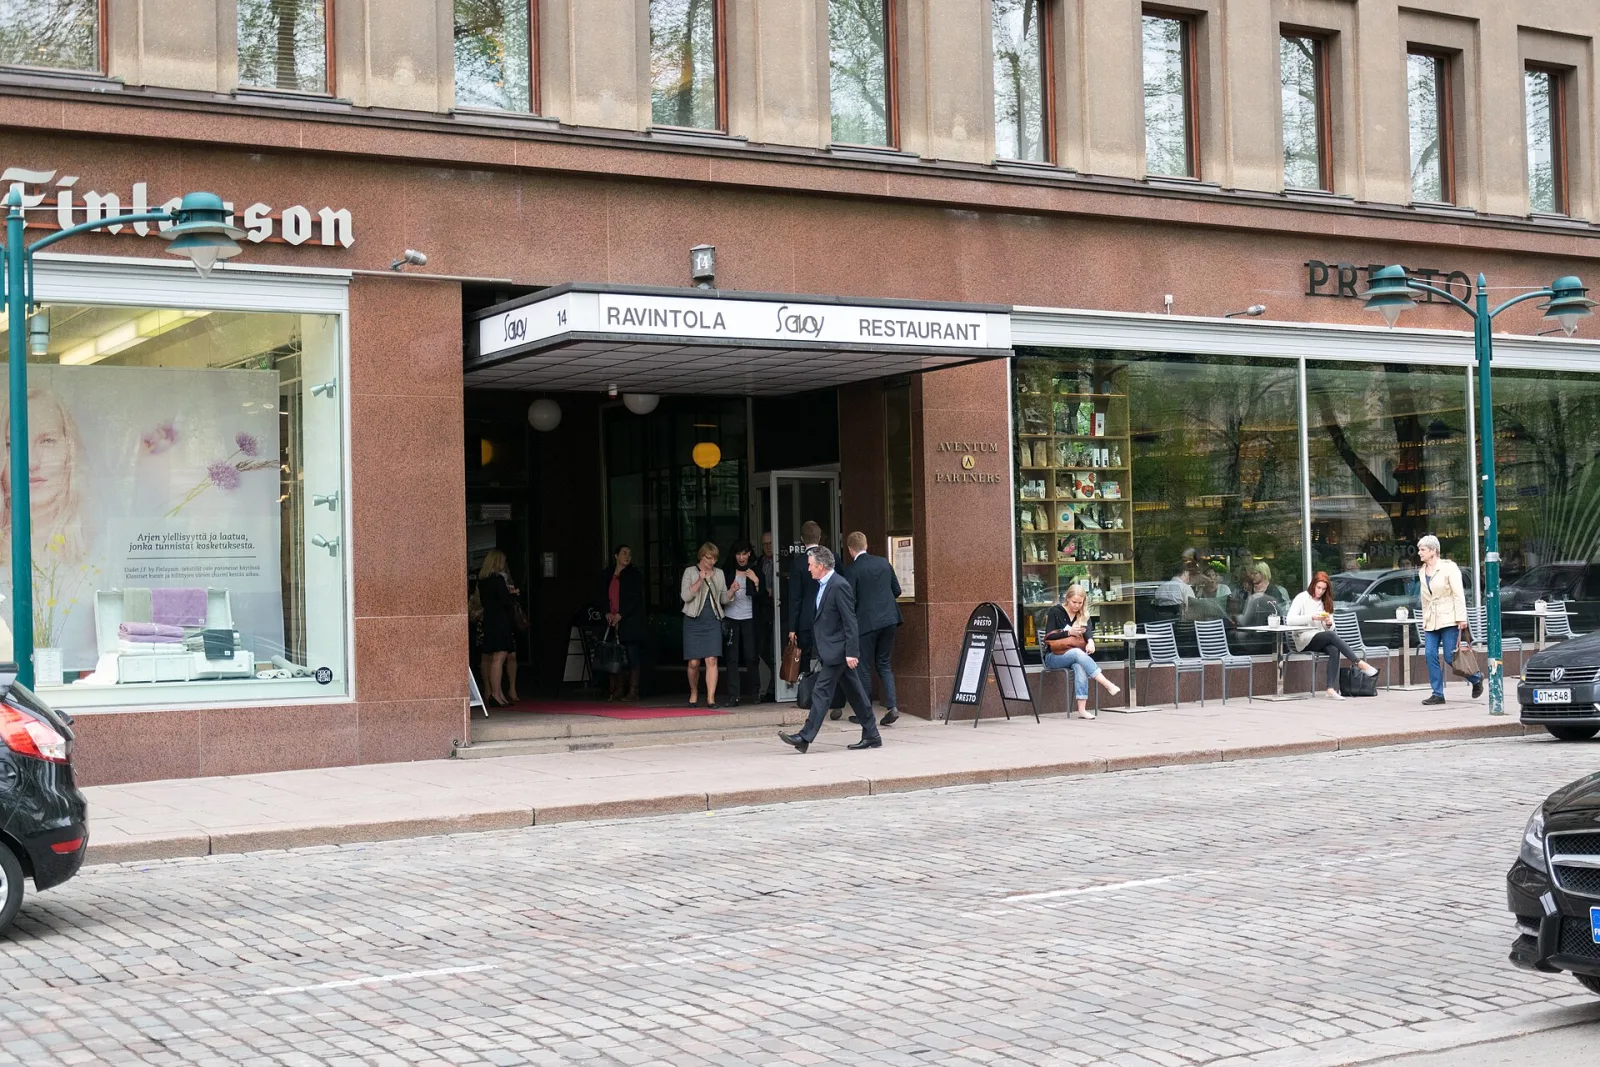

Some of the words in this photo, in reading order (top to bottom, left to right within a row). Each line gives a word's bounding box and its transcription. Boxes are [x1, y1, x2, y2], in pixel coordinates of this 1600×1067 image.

[1309, 260, 1472, 304] PRTO
[557, 309, 567, 326] 14
[607, 307, 726, 330] RAVINTOLA
[776, 306, 824, 338] Savoy
[859, 319, 980, 341] RESTAURANT
[937, 442, 998, 453] AVENTUM
[935, 473, 1001, 483] PARTNERS
[137, 533, 160, 543] Arjen
[162, 532, 207, 543] ylellisyyttä
[209, 533, 217, 542] ja
[220, 532, 248, 541] laatua,
[129, 542, 153, 552] jonka
[155, 542, 194, 550] tunnistat
[197, 541, 255, 550] kosketuksesta.
[1370, 545, 1416, 557] PRESTO
[973, 619, 992, 627] PRESTO
[955, 693, 977, 702] PRESTO
[1538, 691, 1569, 701] OTM-548
